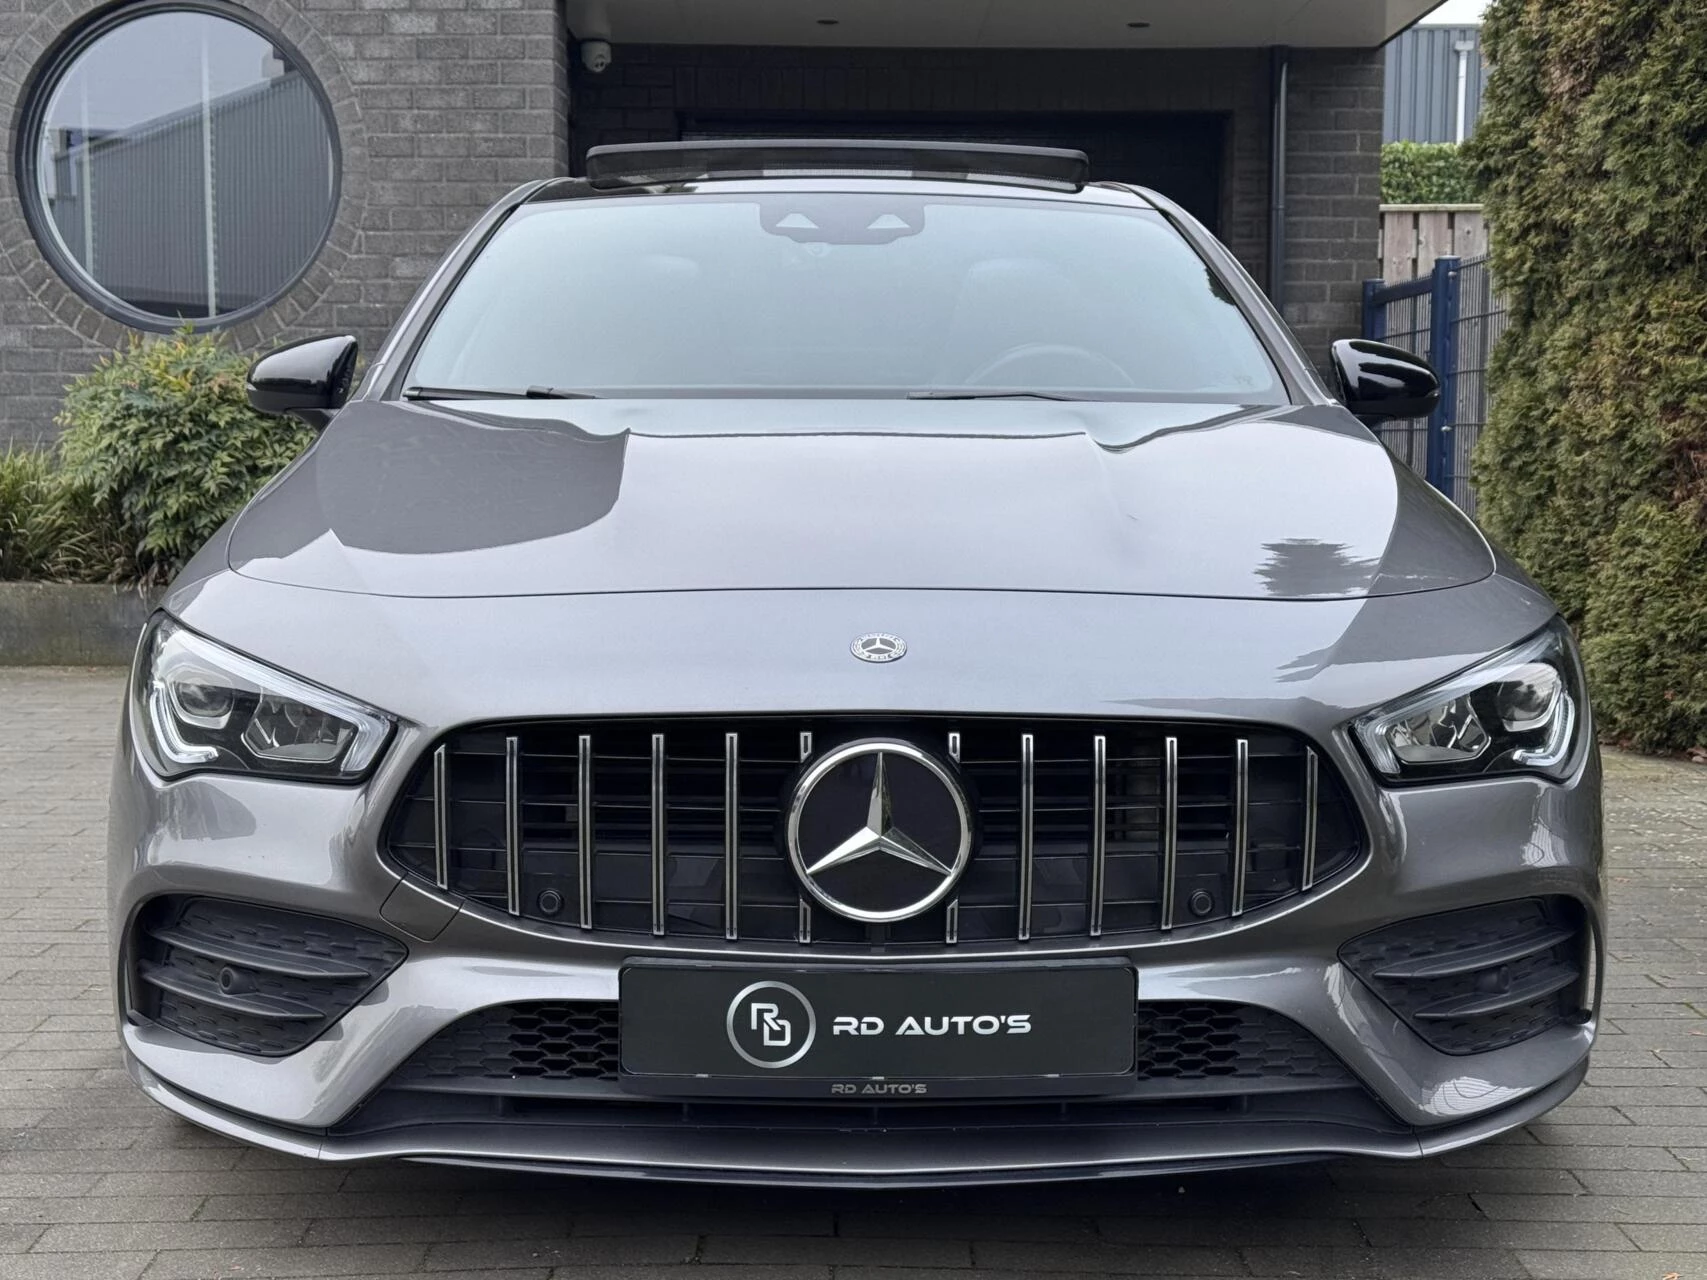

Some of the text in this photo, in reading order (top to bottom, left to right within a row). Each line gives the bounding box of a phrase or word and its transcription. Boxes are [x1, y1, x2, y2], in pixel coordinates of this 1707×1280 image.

[832, 1015, 1032, 1036] RD AUTO'S
[831, 1083, 927, 1094] RD AUTO'S
